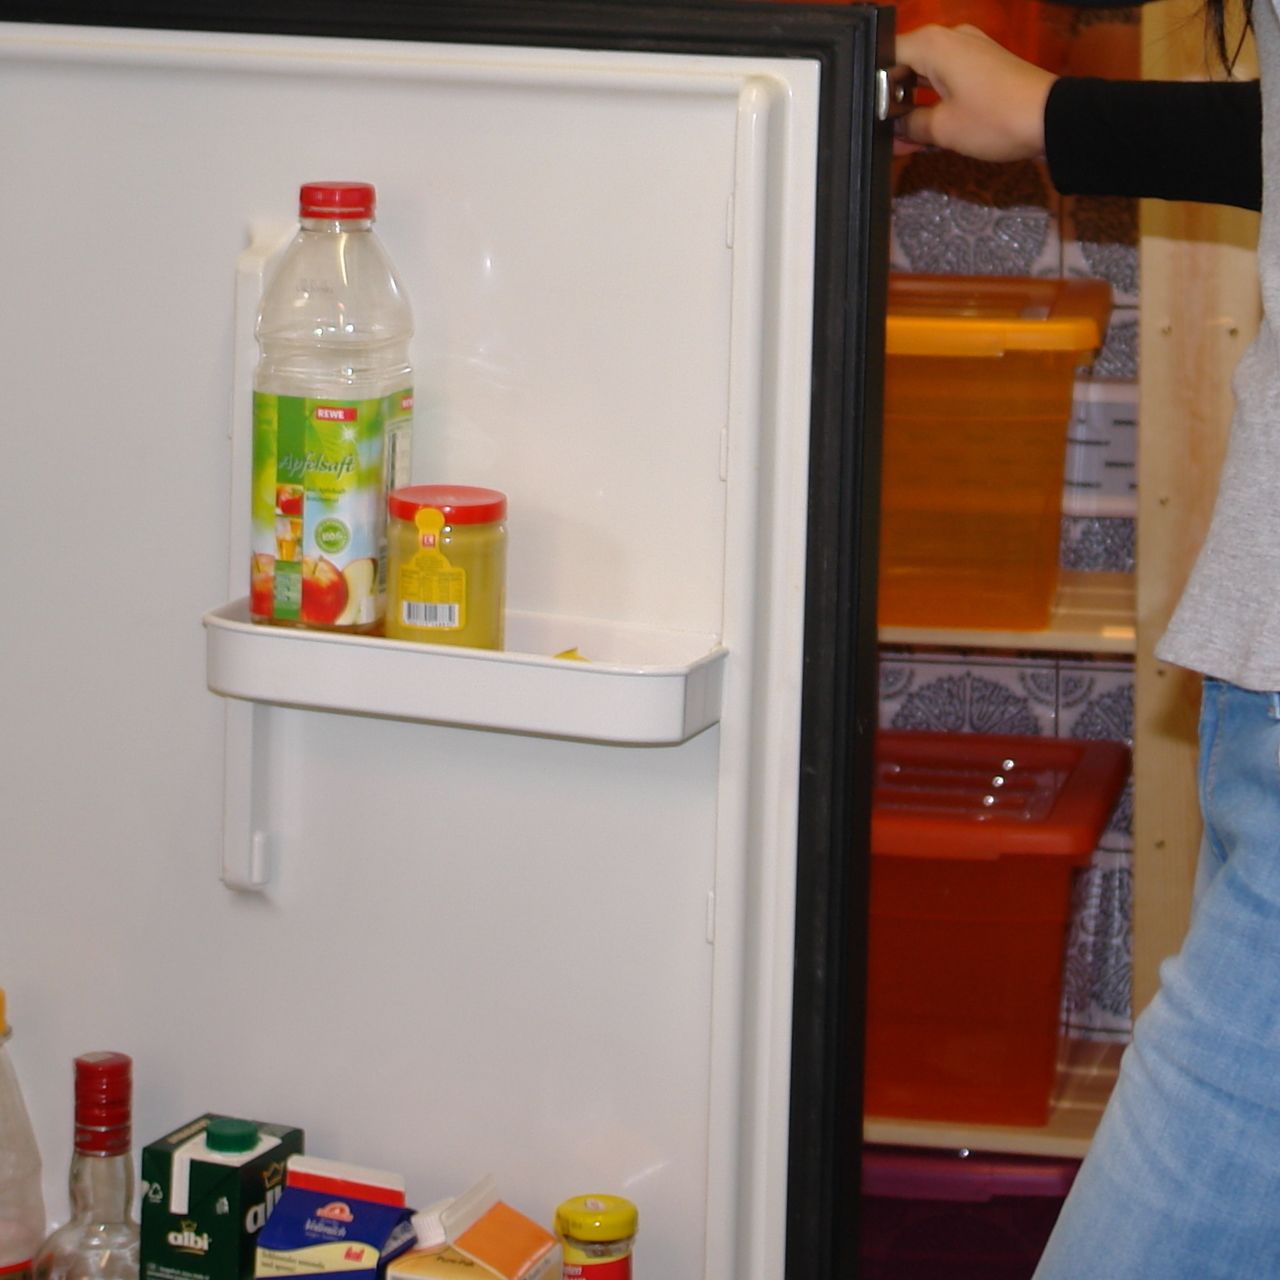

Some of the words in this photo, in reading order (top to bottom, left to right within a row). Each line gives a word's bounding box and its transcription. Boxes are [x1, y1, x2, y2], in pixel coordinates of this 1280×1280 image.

[317, 408, 345, 420] REWE
[279, 451, 354, 480] Apfelsaft
[167, 1231, 210, 1251] albi
